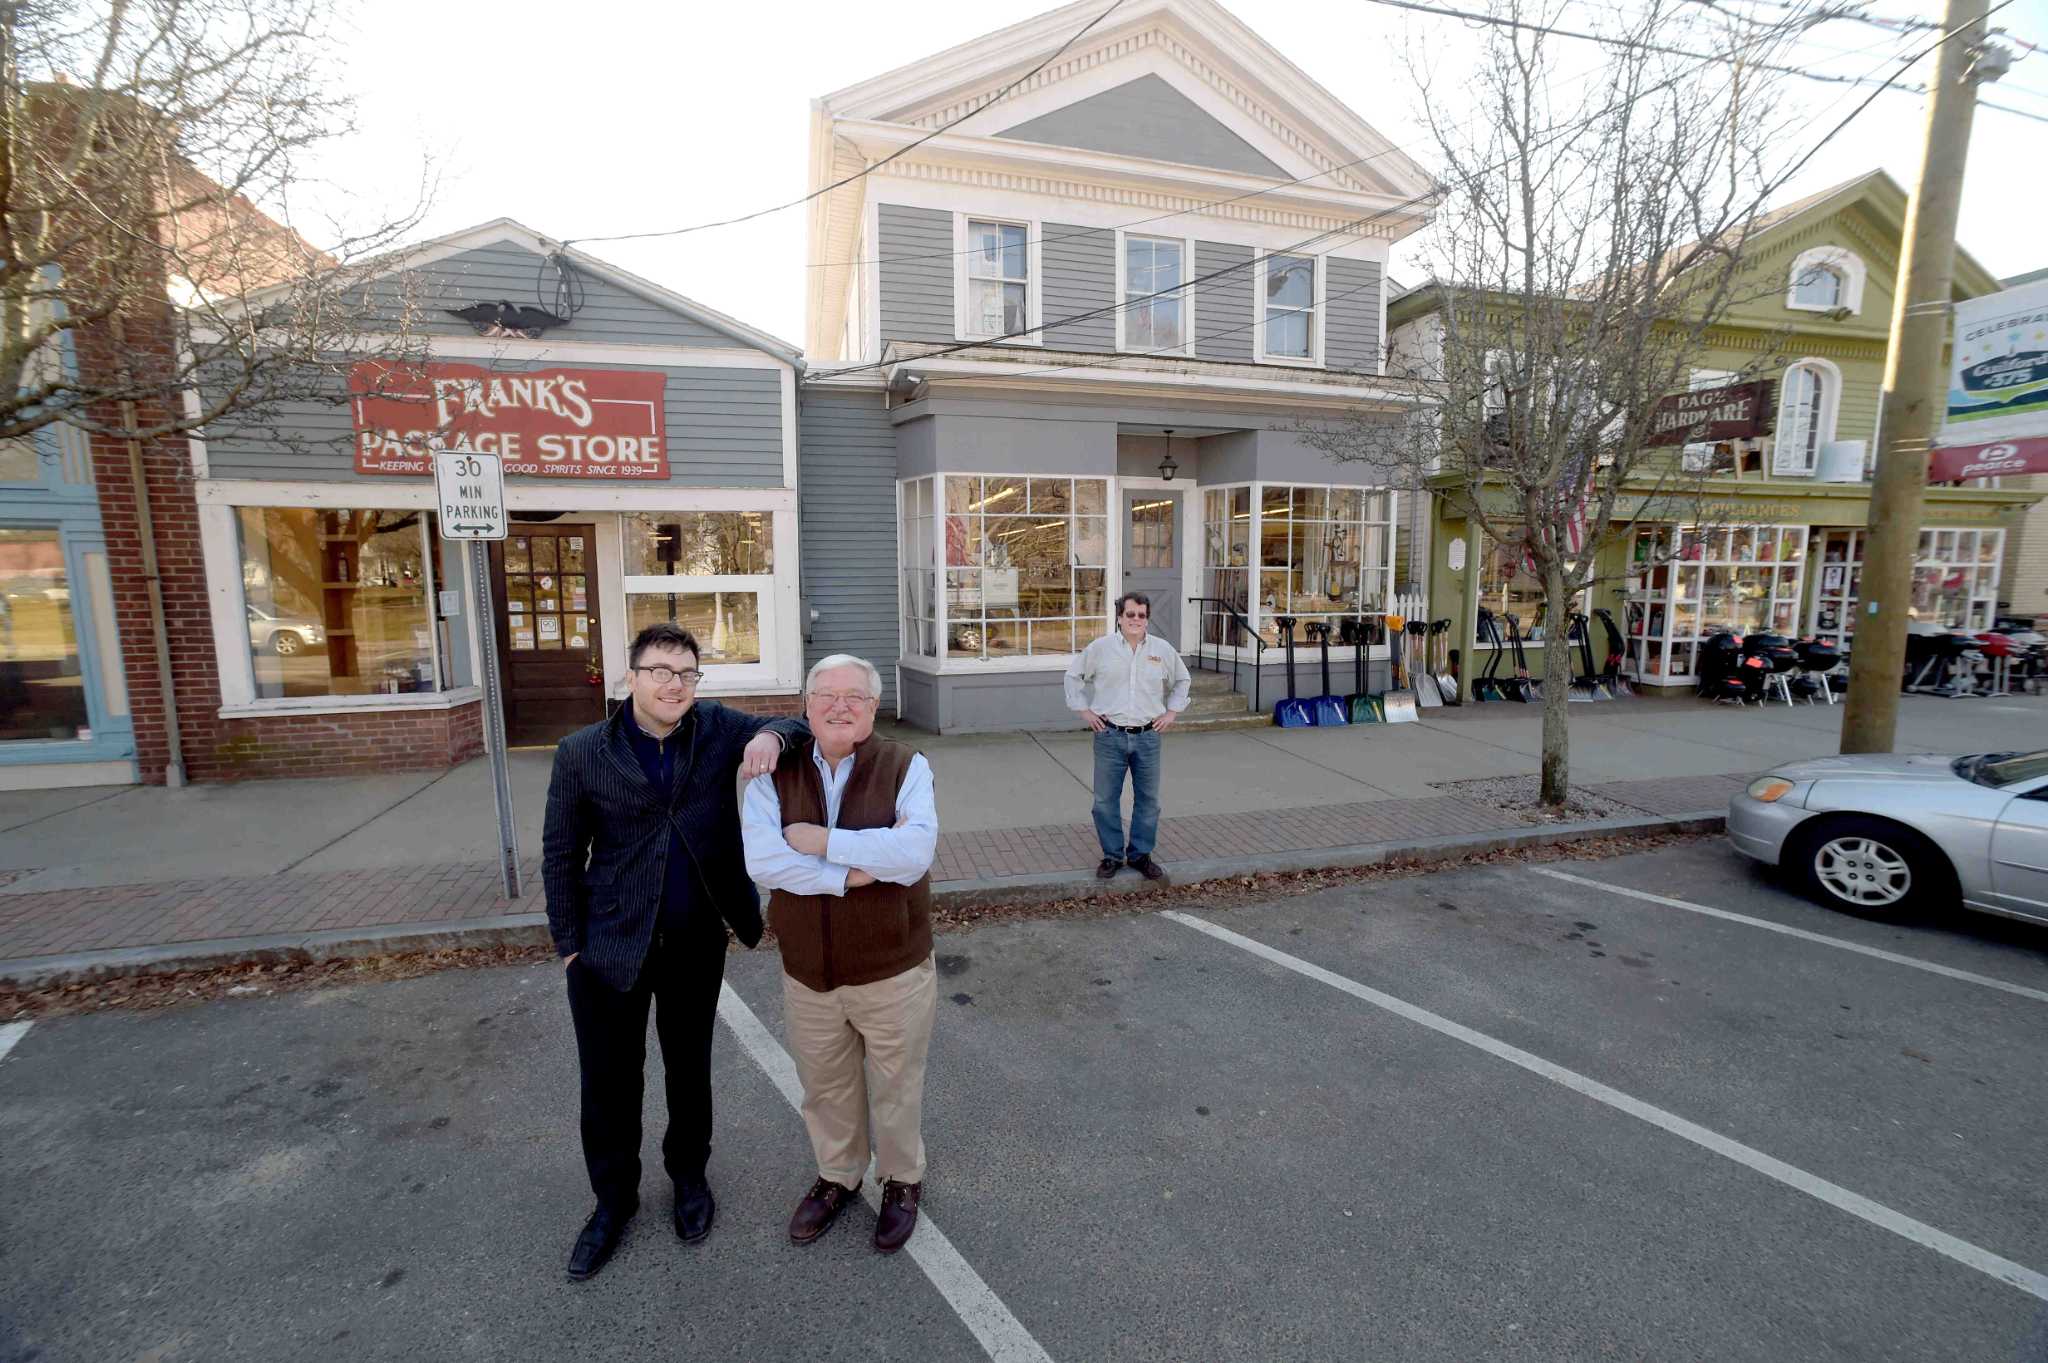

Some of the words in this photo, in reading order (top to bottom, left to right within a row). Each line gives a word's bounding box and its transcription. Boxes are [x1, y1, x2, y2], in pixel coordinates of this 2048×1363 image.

[1965, 313, 2048, 342] CELEBRA
[432, 375, 593, 428] FRANK'S
[361, 429, 521, 460] PACKAGE
[537, 434, 661, 463] STORE
[378, 461, 425, 472] KEEPING
[504, 463, 538, 473] GOOD
[543, 464, 582, 474] SPIRITS
[586, 465, 617, 475] SINCE
[621, 465, 642, 476] 1939
[455, 460, 482, 477] 30
[1961, 460, 2026, 477] pearce
[460, 485, 482, 499] MIN
[446, 505, 498, 519] PARKING
